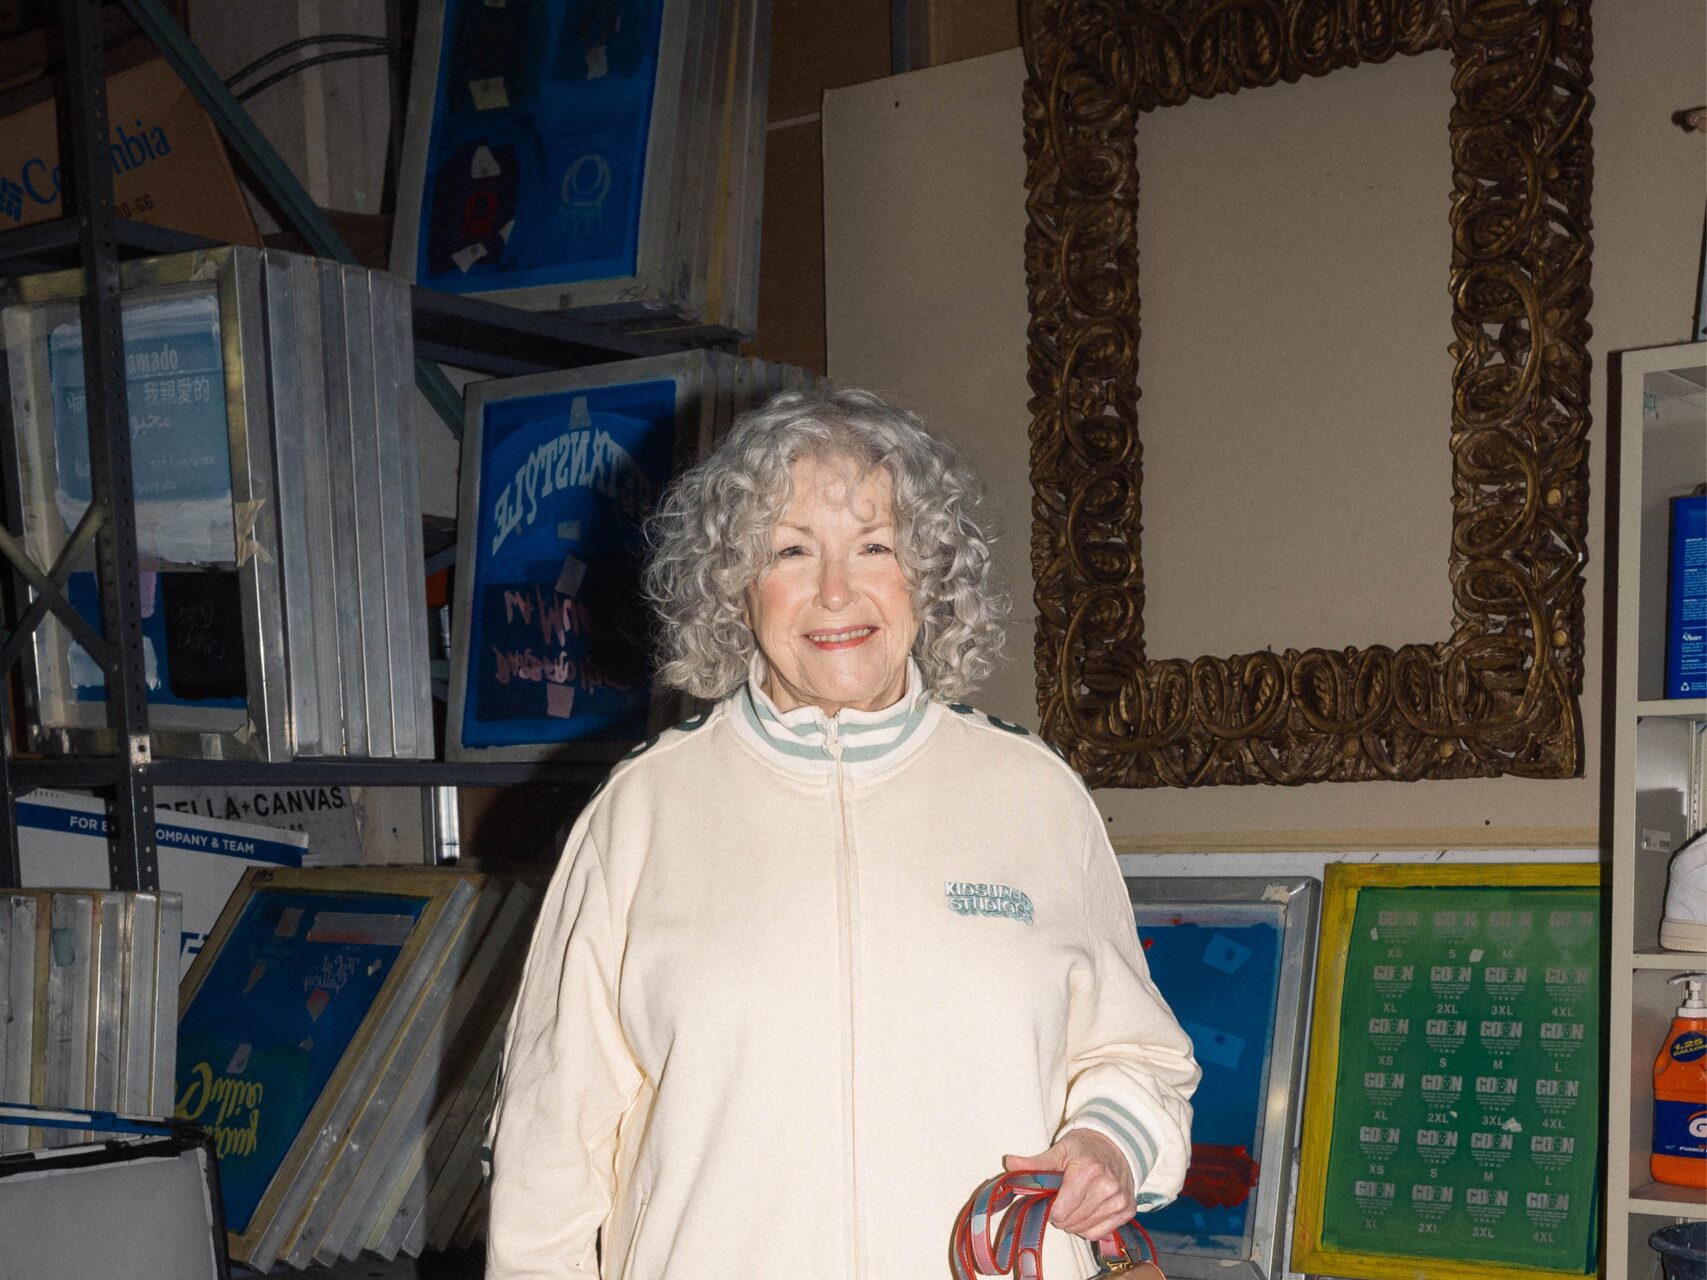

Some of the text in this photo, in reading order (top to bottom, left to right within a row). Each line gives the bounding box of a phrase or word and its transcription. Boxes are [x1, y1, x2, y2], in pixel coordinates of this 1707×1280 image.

[22, 119, 172, 205] Combia
[156, 786, 345, 820] ELLA+CANVAS
[70, 815, 98, 831] FOR
[155, 829, 255, 856] OMPANY & TEAM
[1387, 949, 1402, 959] XS
[1448, 949, 1456, 959] S
[1503, 950, 1513, 960] M
[1383, 1003, 1397, 1013] XL
[1437, 1004, 1458, 1015] 2XL
[1491, 1005, 1514, 1016] 3XL
[1551, 1006, 1574, 1017] 4XL
[1673, 1038, 1704, 1050] 1.25
[1377, 1056, 1393, 1066] XS
[1439, 1058, 1447, 1068] S
[1493, 1059, 1503, 1070] M
[1554, 1062, 1562, 1072] L
[1374, 1110, 1388, 1120] XL
[1427, 1113, 1448, 1124] 2XL
[1481, 1115, 1504, 1126] 3XL
[1542, 1117, 1565, 1129] 4XL
[1688, 1117, 1707, 1138] G
[1368, 1164, 1384, 1175] XS
[1430, 1168, 1438, 1178] S
[1483, 1171, 1493, 1182] M
[1545, 1175, 1552, 1186] L
[1364, 1219, 1378, 1229] XL
[1418, 1223, 1440, 1234] 2XL
[1472, 1227, 1495, 1239] 3XL
[1532, 1231, 1555, 1243] 4XL
